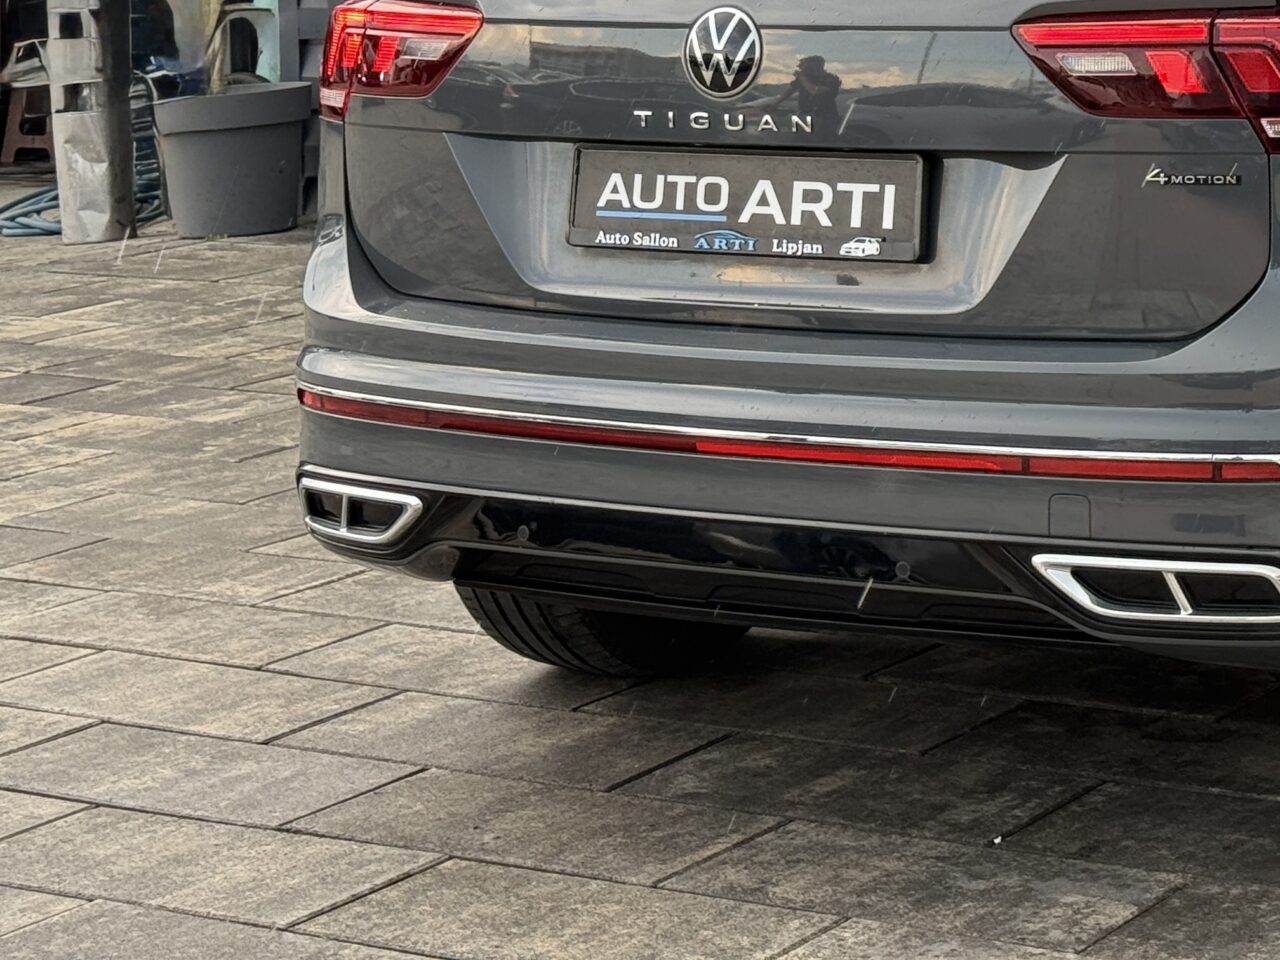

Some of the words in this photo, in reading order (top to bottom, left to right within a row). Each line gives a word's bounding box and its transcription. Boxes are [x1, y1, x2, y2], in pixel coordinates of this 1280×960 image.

[633, 110, 813, 133] TIGUAN
[1144, 168, 1238, 185] 4MOTION
[596, 172, 730, 213] AUTO
[737, 179, 897, 230] ARTI
[594, 231, 630, 246] Auto
[633, 232, 679, 248] Sallon
[694, 237, 758, 252] ARTI
[771, 239, 824, 255] Lipjan
